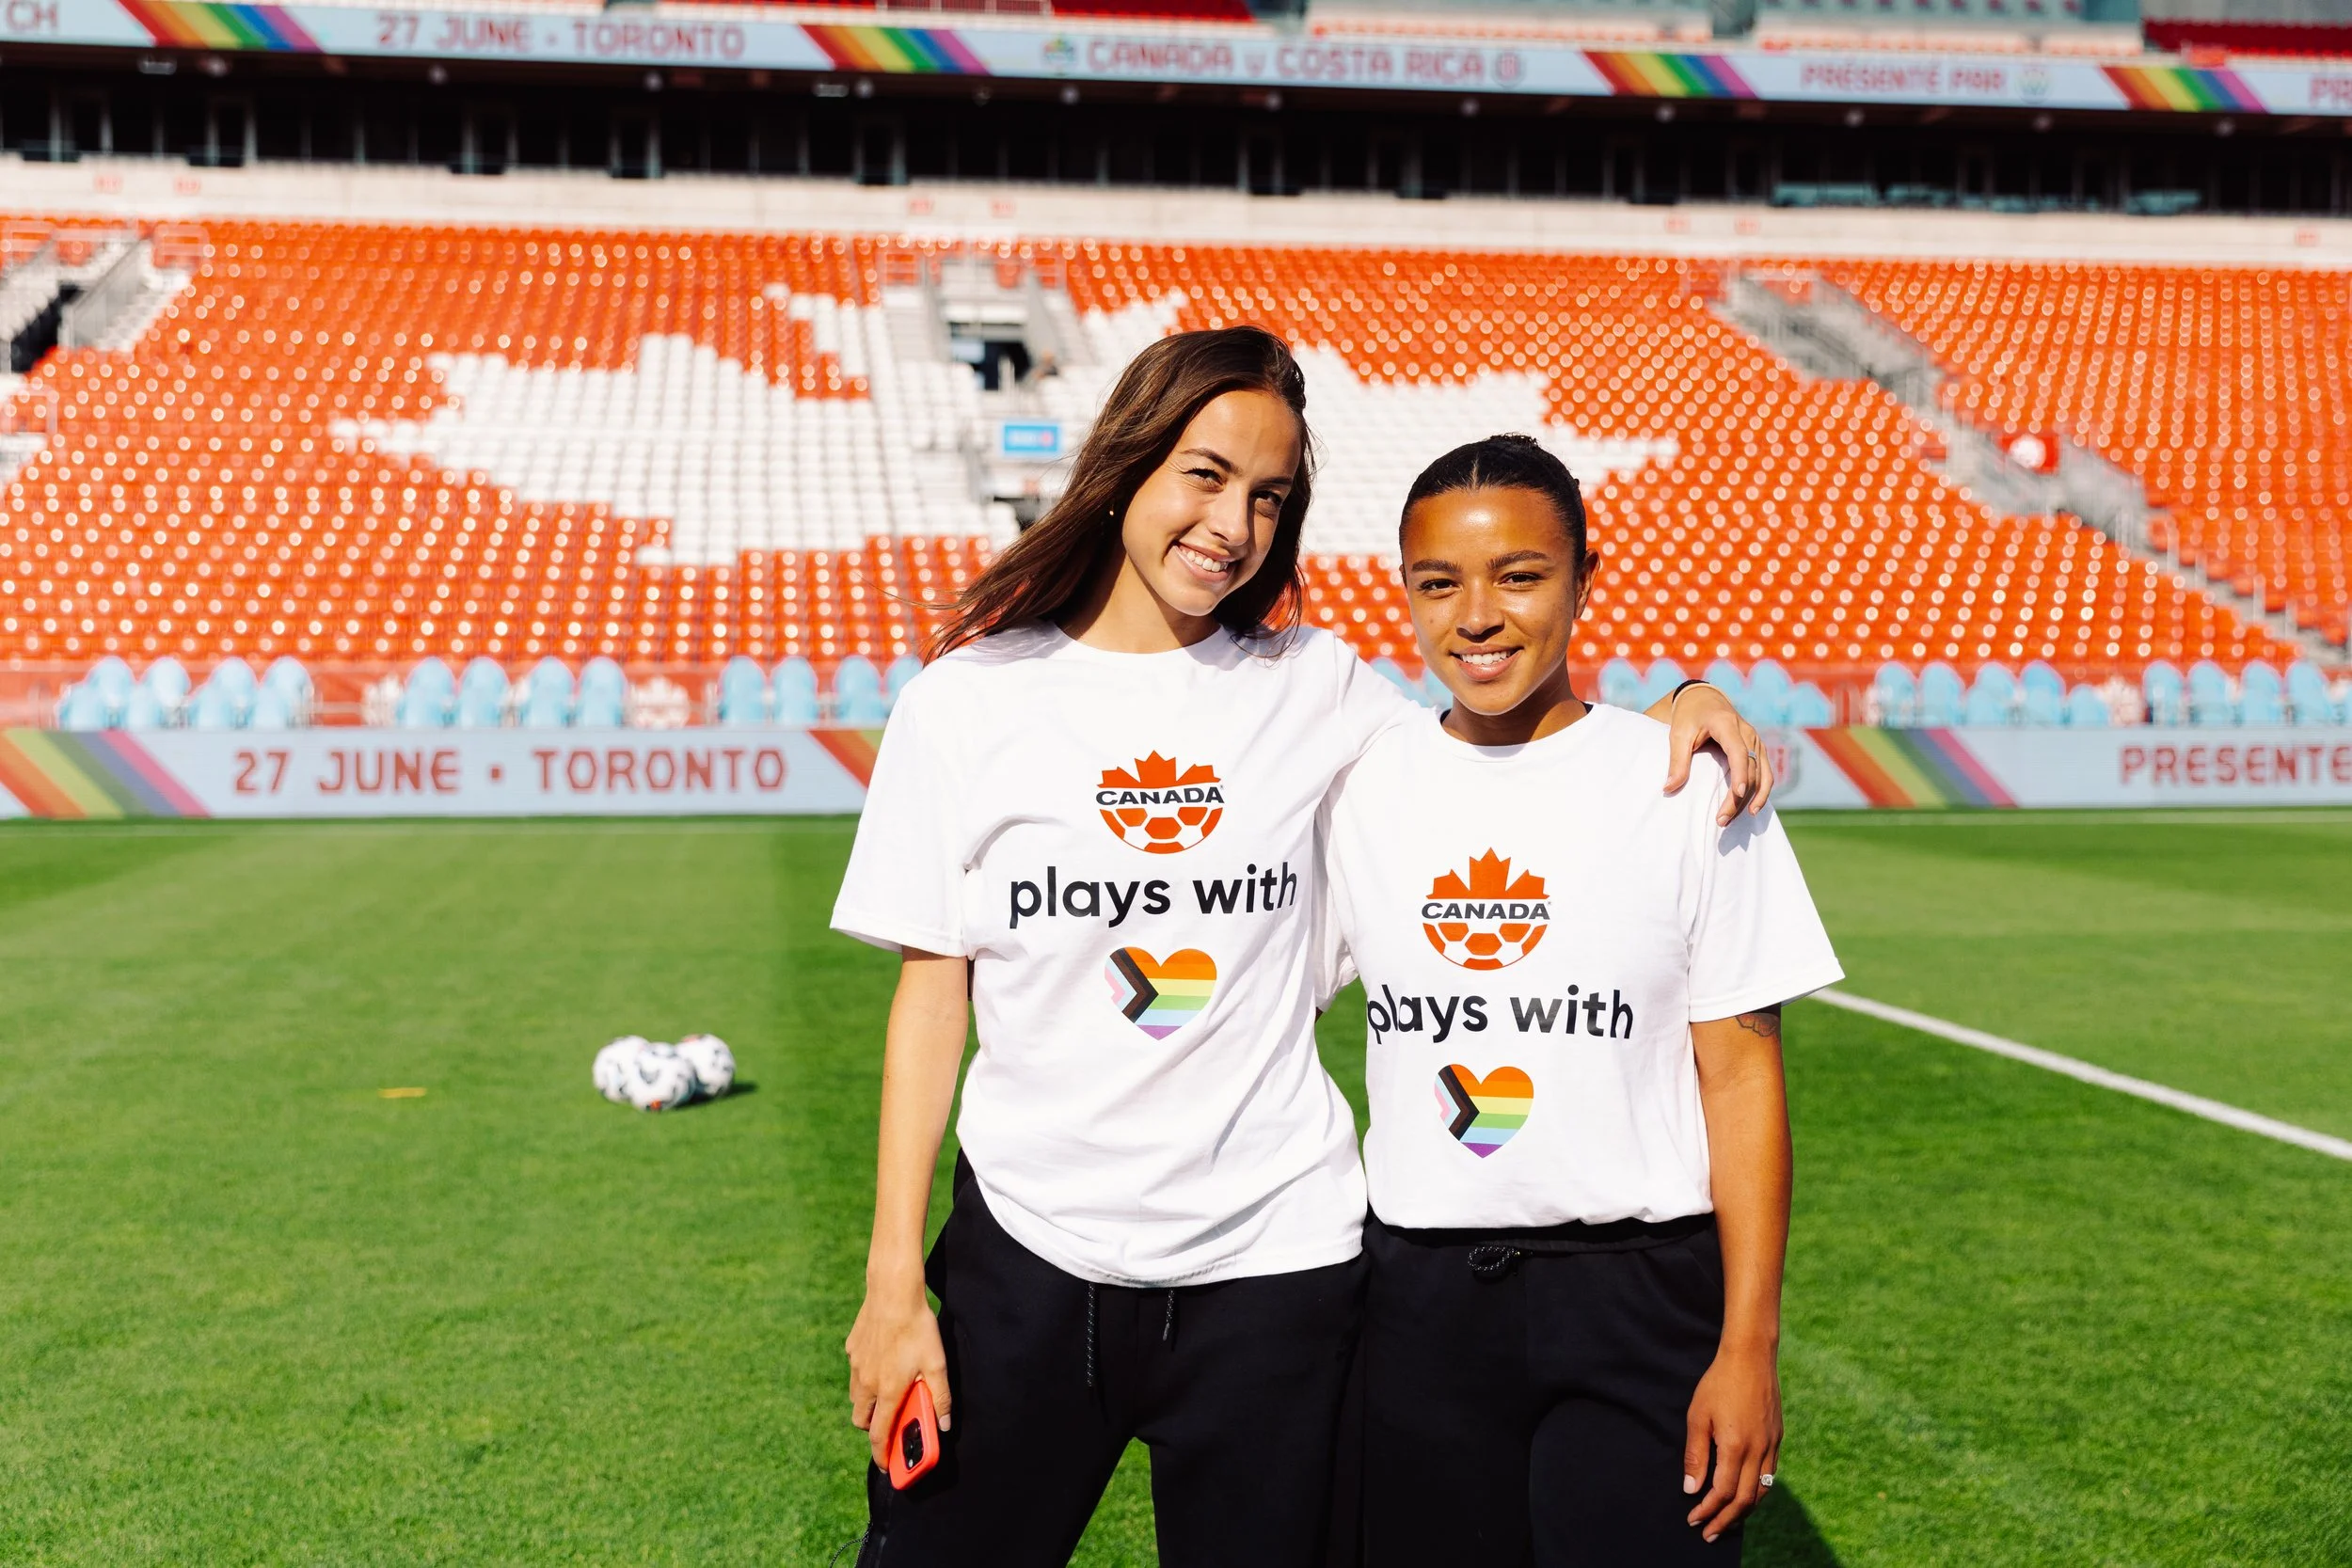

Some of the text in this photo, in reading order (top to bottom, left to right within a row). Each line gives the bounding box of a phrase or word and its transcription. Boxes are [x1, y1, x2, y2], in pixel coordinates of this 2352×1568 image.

[377, 14, 745, 60] 27 JUNE TORONTO
[1087, 40, 1234, 76] CANADA
[1276, 46, 1393, 81] COSTA
[1406, 50, 1483, 86] RICA
[234, 748, 787, 794] 27 JUNE TORONTO
[2121, 745, 2352, 784] PRESENTE
[1096, 786, 1225, 806] CANADA
[1009, 862, 1297, 929] plays with
[1422, 902, 1550, 920] CANADA
[1367, 984, 1634, 1044] plays with
